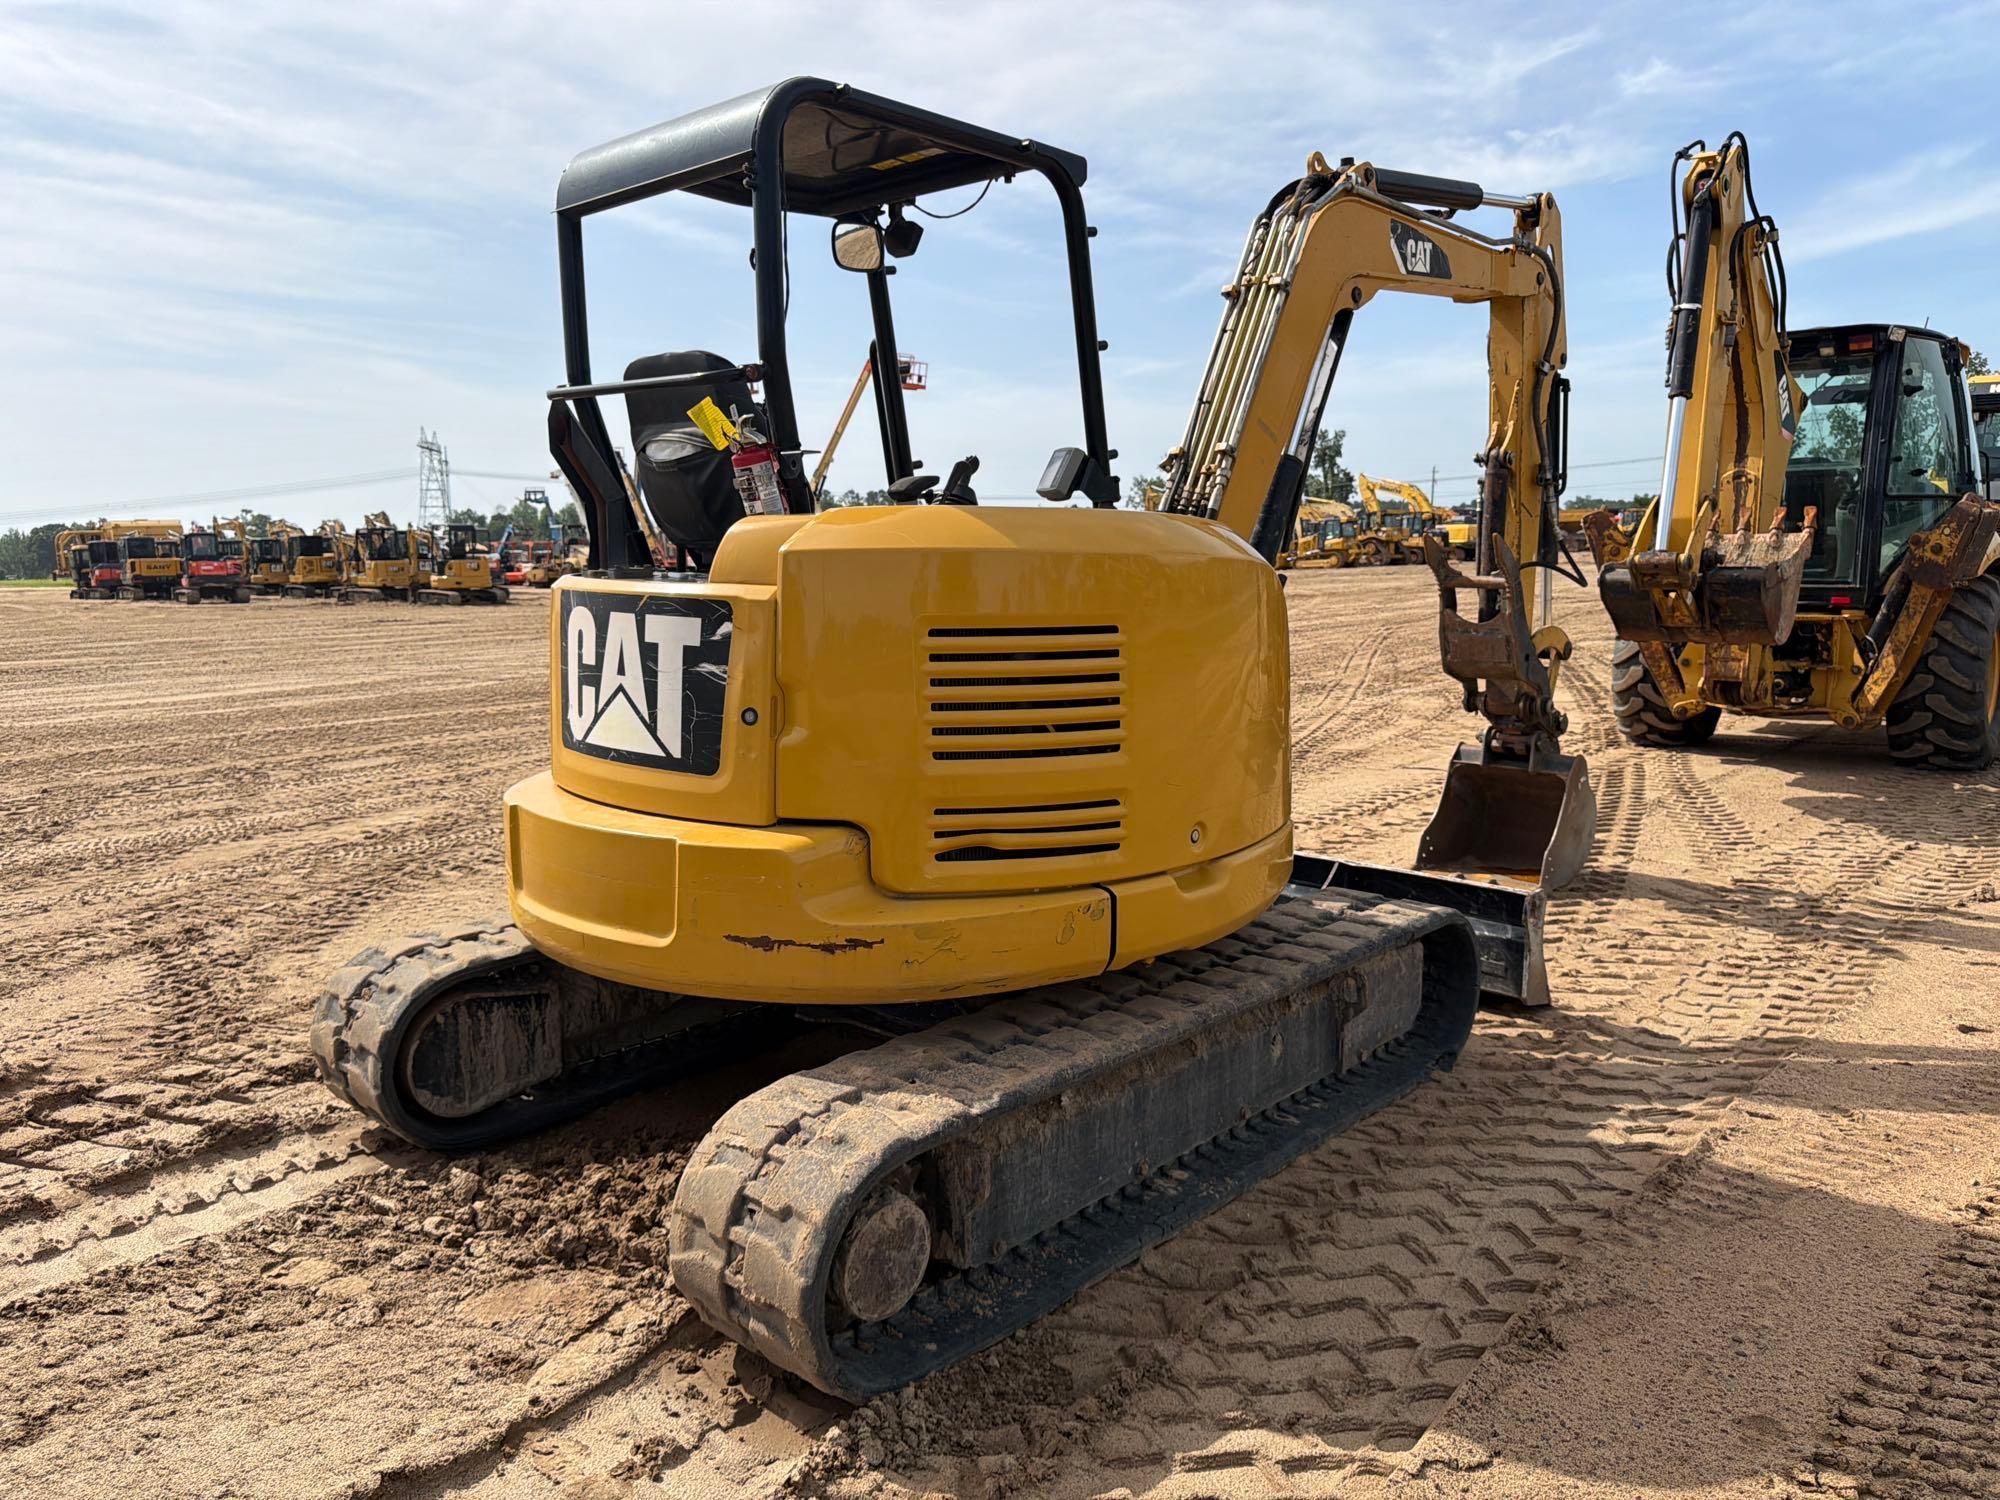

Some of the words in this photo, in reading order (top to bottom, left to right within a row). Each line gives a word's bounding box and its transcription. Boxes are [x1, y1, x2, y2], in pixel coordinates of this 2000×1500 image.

[1407, 238, 1433, 274] CAT
[1779, 373, 1790, 422] CAT
[568, 606, 702, 759] CAT
